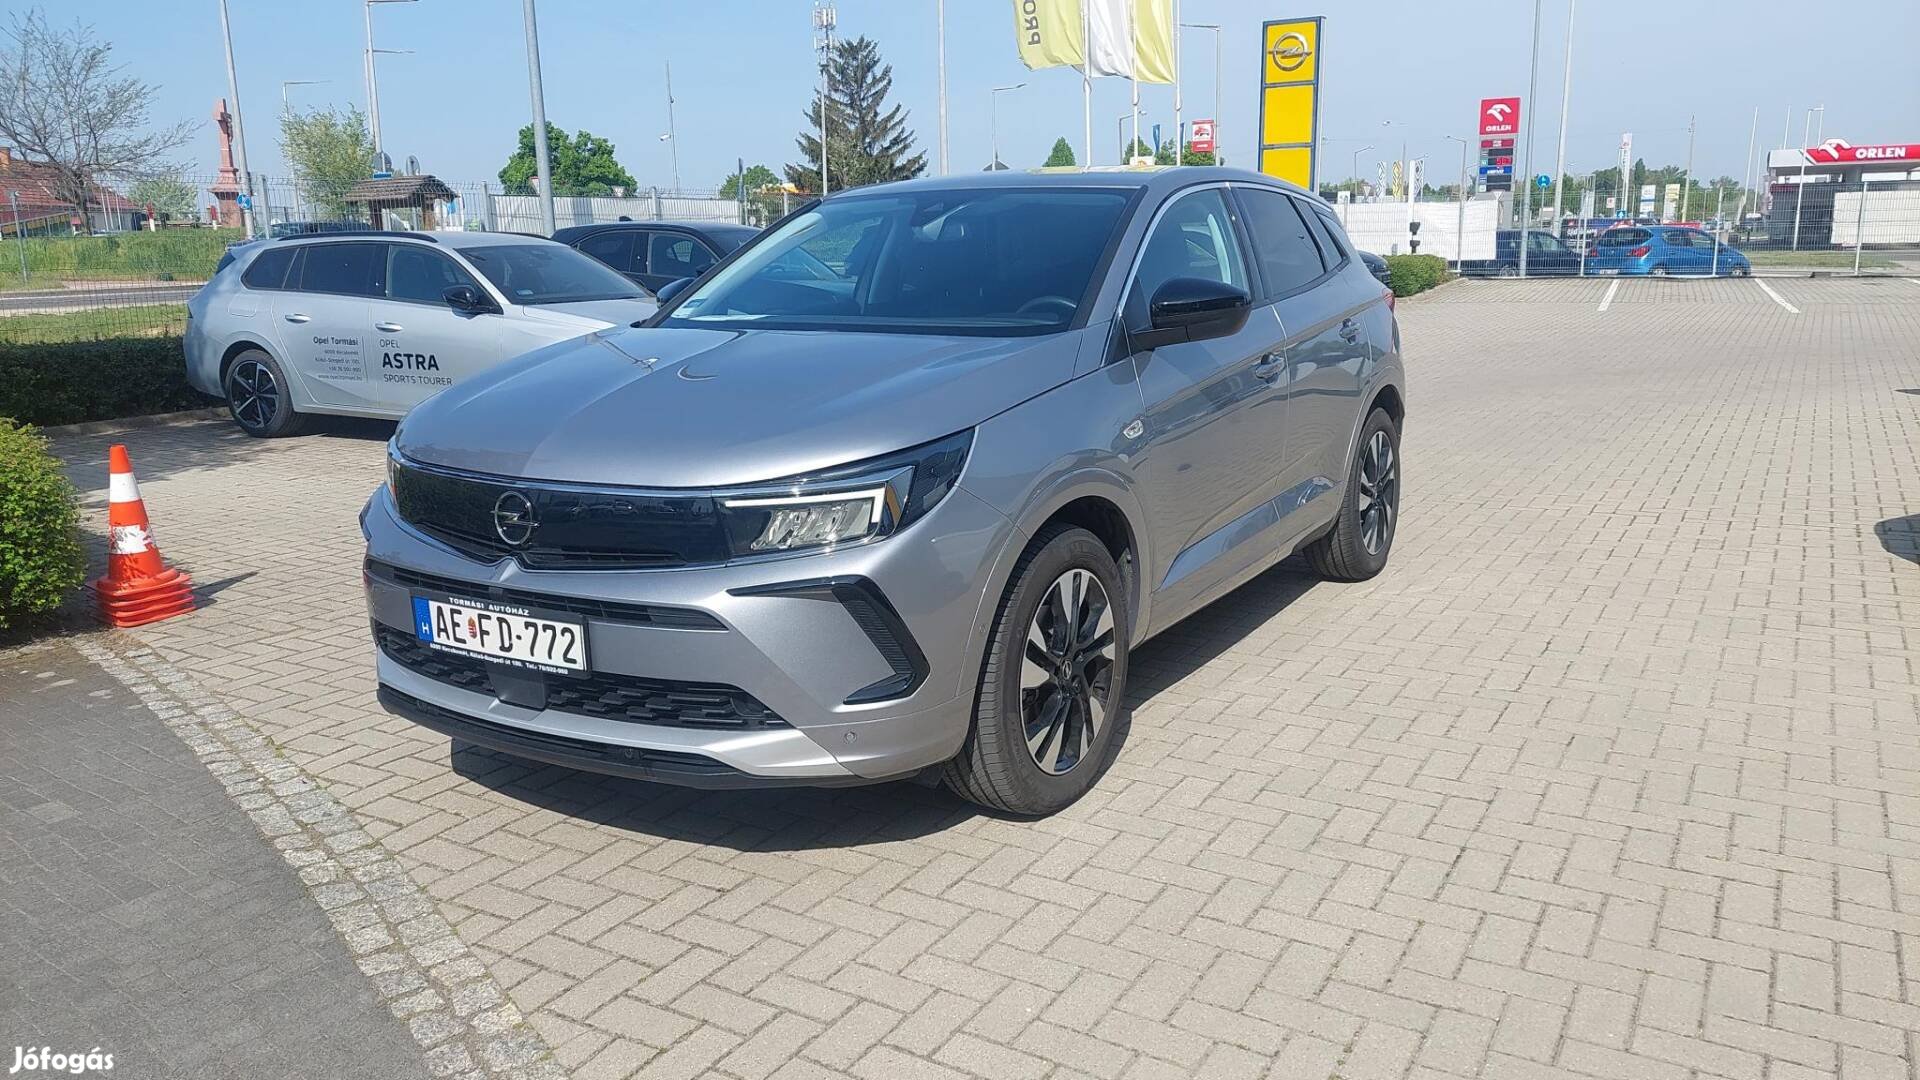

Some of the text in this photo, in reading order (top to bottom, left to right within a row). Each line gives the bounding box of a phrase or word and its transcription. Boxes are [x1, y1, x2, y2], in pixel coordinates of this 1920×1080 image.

[1486, 124, 1512, 132] ORLEN
[1855, 147, 1906, 159] ORLEN
[313, 336, 359, 346] Opel Tormási
[379, 338, 400, 349] OPEL
[382, 352, 440, 371] ASTRA
[383, 373, 452, 386] SPORTS TOURER
[449, 597, 530, 616] TORMÁSI AUTÓHÁZ
[421, 622, 430, 634] H
[437, 606, 577, 664] AE FD-772
